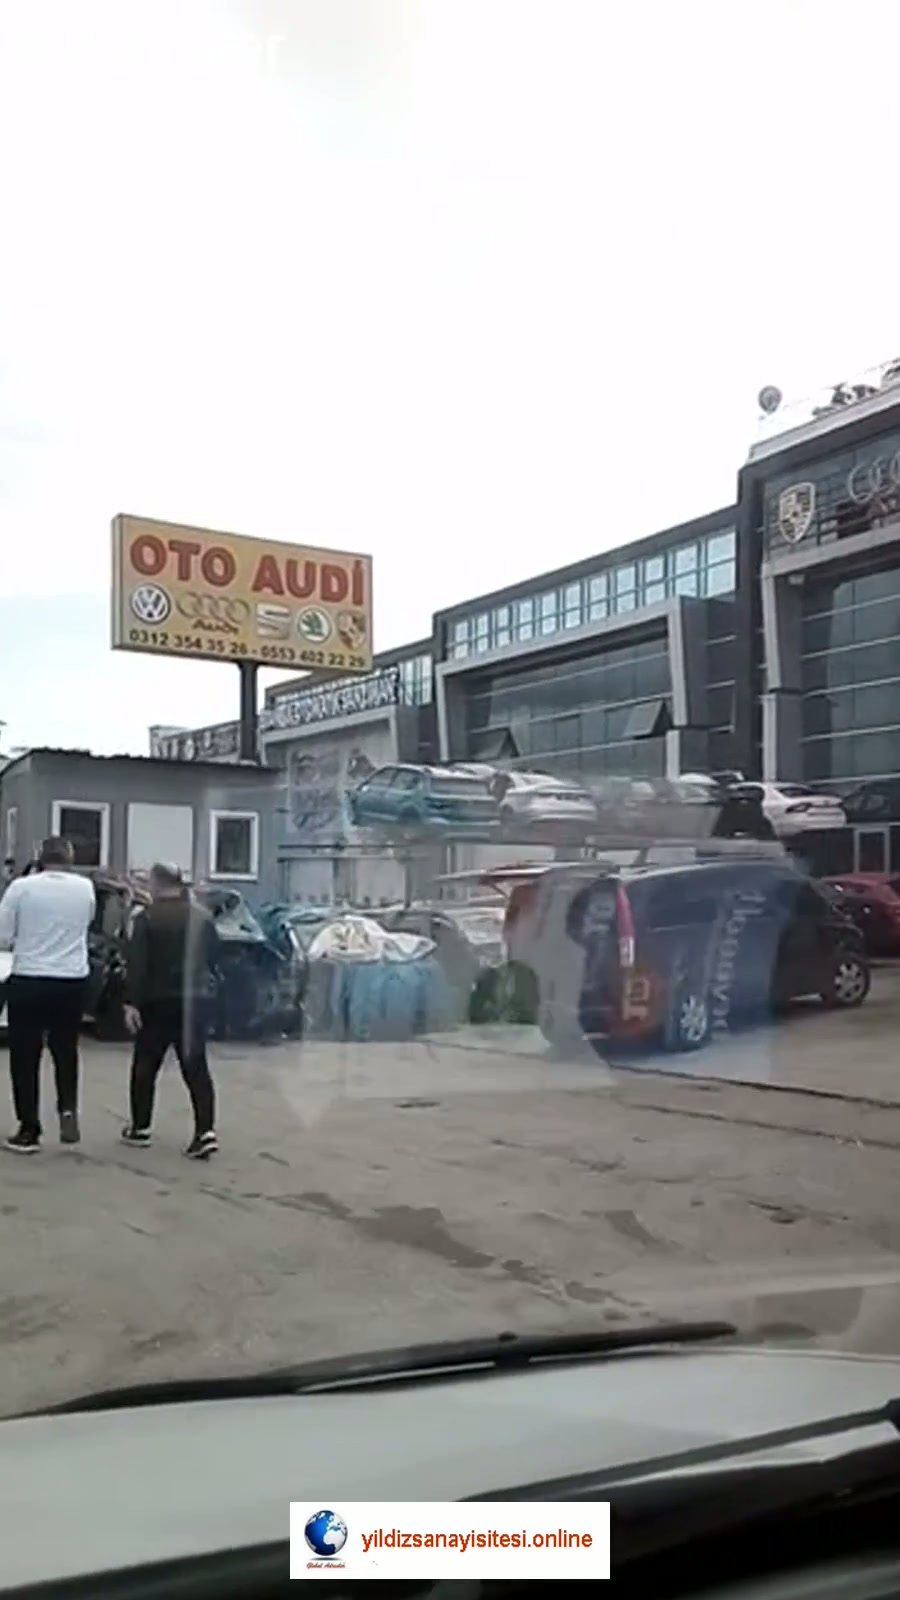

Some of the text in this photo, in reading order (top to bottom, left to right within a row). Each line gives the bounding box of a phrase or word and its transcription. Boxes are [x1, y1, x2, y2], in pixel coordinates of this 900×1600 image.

[130, 535, 364, 605] OTO AUDİ
[129, 629, 169, 646] 0312
[174, 635, 202, 649] 354
[207, 639, 225, 653] 35
[260, 645, 296, 661] 0553
[328, 652, 346, 666] 22
